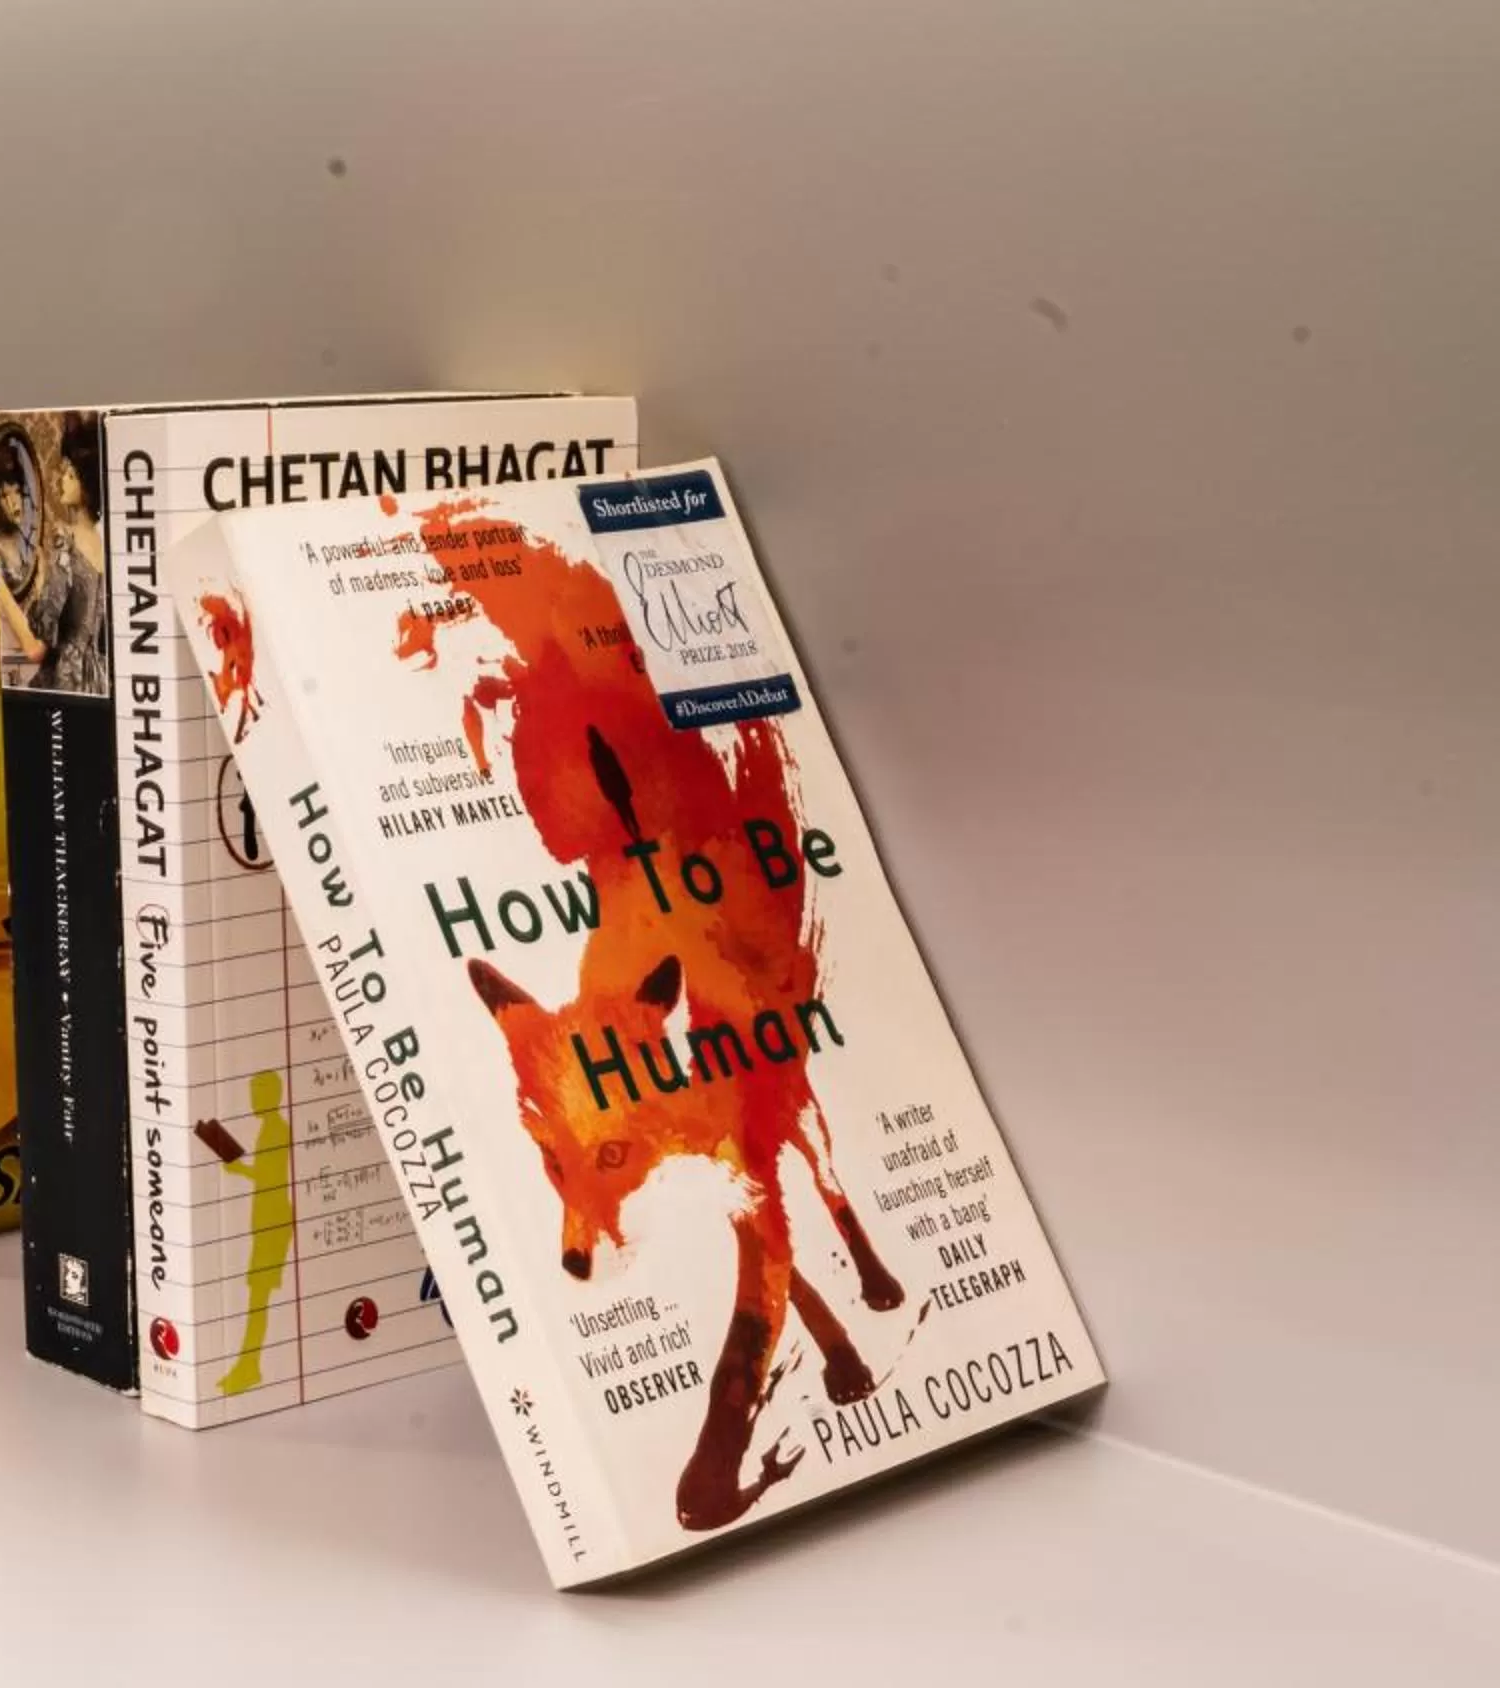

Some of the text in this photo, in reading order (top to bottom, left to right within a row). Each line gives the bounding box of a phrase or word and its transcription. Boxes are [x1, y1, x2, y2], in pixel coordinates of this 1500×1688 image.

[203, 438, 614, 511] CHETAN BHAGAT
[593, 489, 707, 518] Shortlisted for
[321, 536, 386, 565] powerful
[391, 533, 420, 556] and
[421, 528, 469, 552] tender
[473, 524, 527, 550] portrait
[645, 552, 725, 579] DESMOND
[329, 574, 346, 596] of
[423, 565, 455, 585] love
[460, 560, 488, 582] and
[422, 593, 476, 622] paper
[122, 449, 167, 877] CHETAN BHAGAT
[679, 639, 759, 667] PRIZE 2018
[675, 689, 789, 718] #DiscoverADebut
[379, 767, 495, 803] and subversive
[378, 794, 525, 840] HILARY MANTEL
[423, 818, 844, 958] How To Be
[49, 709, 76, 1145] WILLIAM THACKERAY Vanity Fair
[289, 781, 355, 908] How
[348, 928, 388, 1005] To
[381, 1025, 426, 1102] Be
[421, 1126, 521, 1344] Human
[317, 934, 376, 1047] PAULA
[365, 1057, 444, 1221] COCOZZA
[572, 999, 845, 1110] Human
[134, 912, 172, 1291] Five point someone
[894, 1103, 935, 1131] writer
[881, 1128, 960, 1172] unafraid of
[873, 1155, 996, 1213] launching herself
[905, 1212, 939, 1241] with
[940, 1212, 951, 1231] a
[938, 1233, 989, 1269] DAILY
[930, 1258, 1027, 1311] TELEGRAPH
[577, 1346, 624, 1379] Vivid
[626, 1334, 658, 1366] and
[604, 1361, 704, 1415] OBSERVER
[812, 1330, 1074, 1464] PAULA COCOZZA
[525, 1423, 588, 1564] WINDMILL
